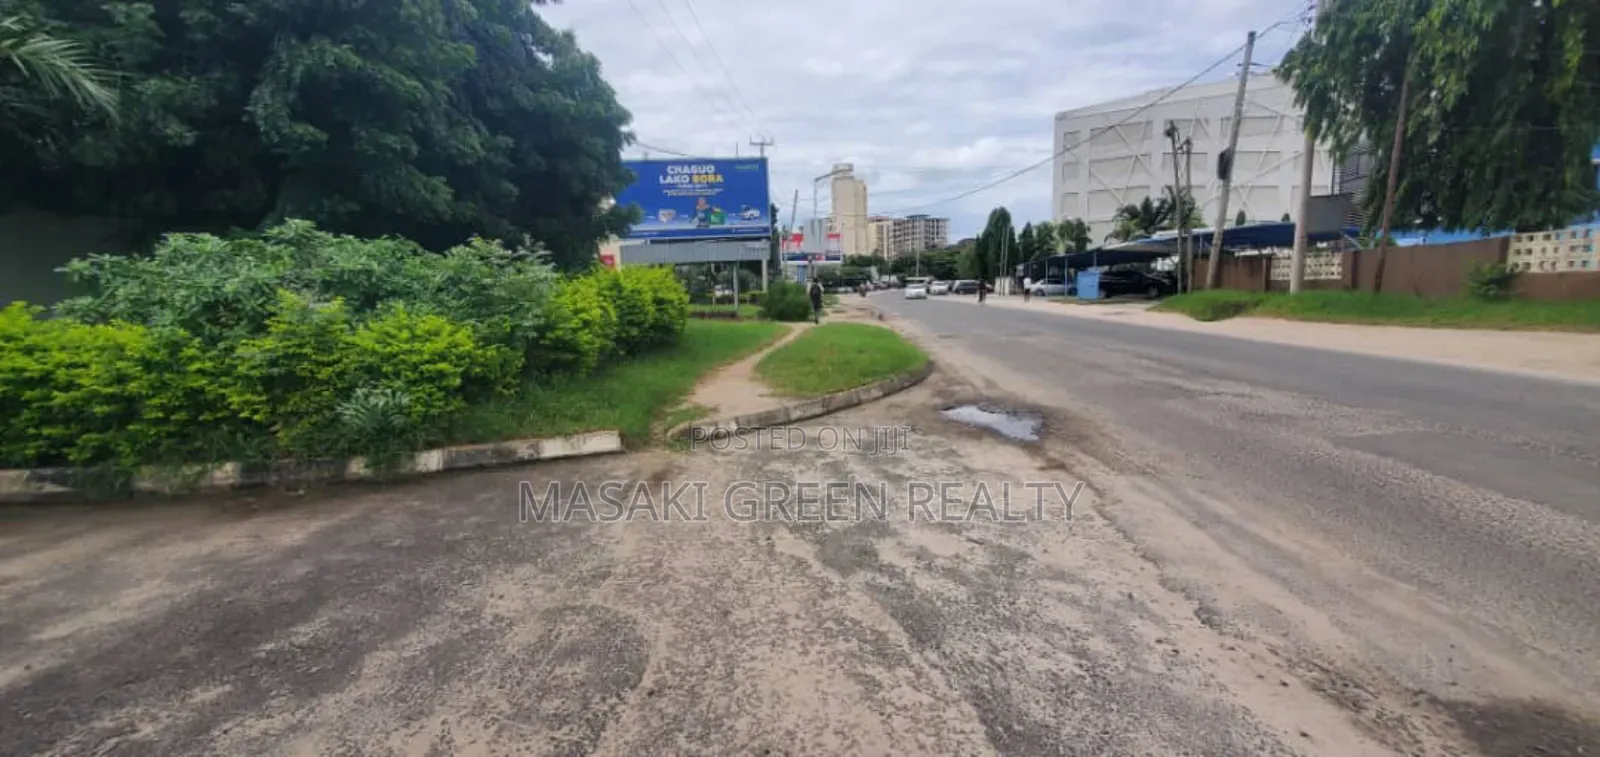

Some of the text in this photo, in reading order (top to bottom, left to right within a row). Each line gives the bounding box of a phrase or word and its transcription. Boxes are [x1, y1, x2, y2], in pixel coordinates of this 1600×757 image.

[666, 165, 715, 174] CHAGUO
[659, 174, 724, 184] LAKO BORA
